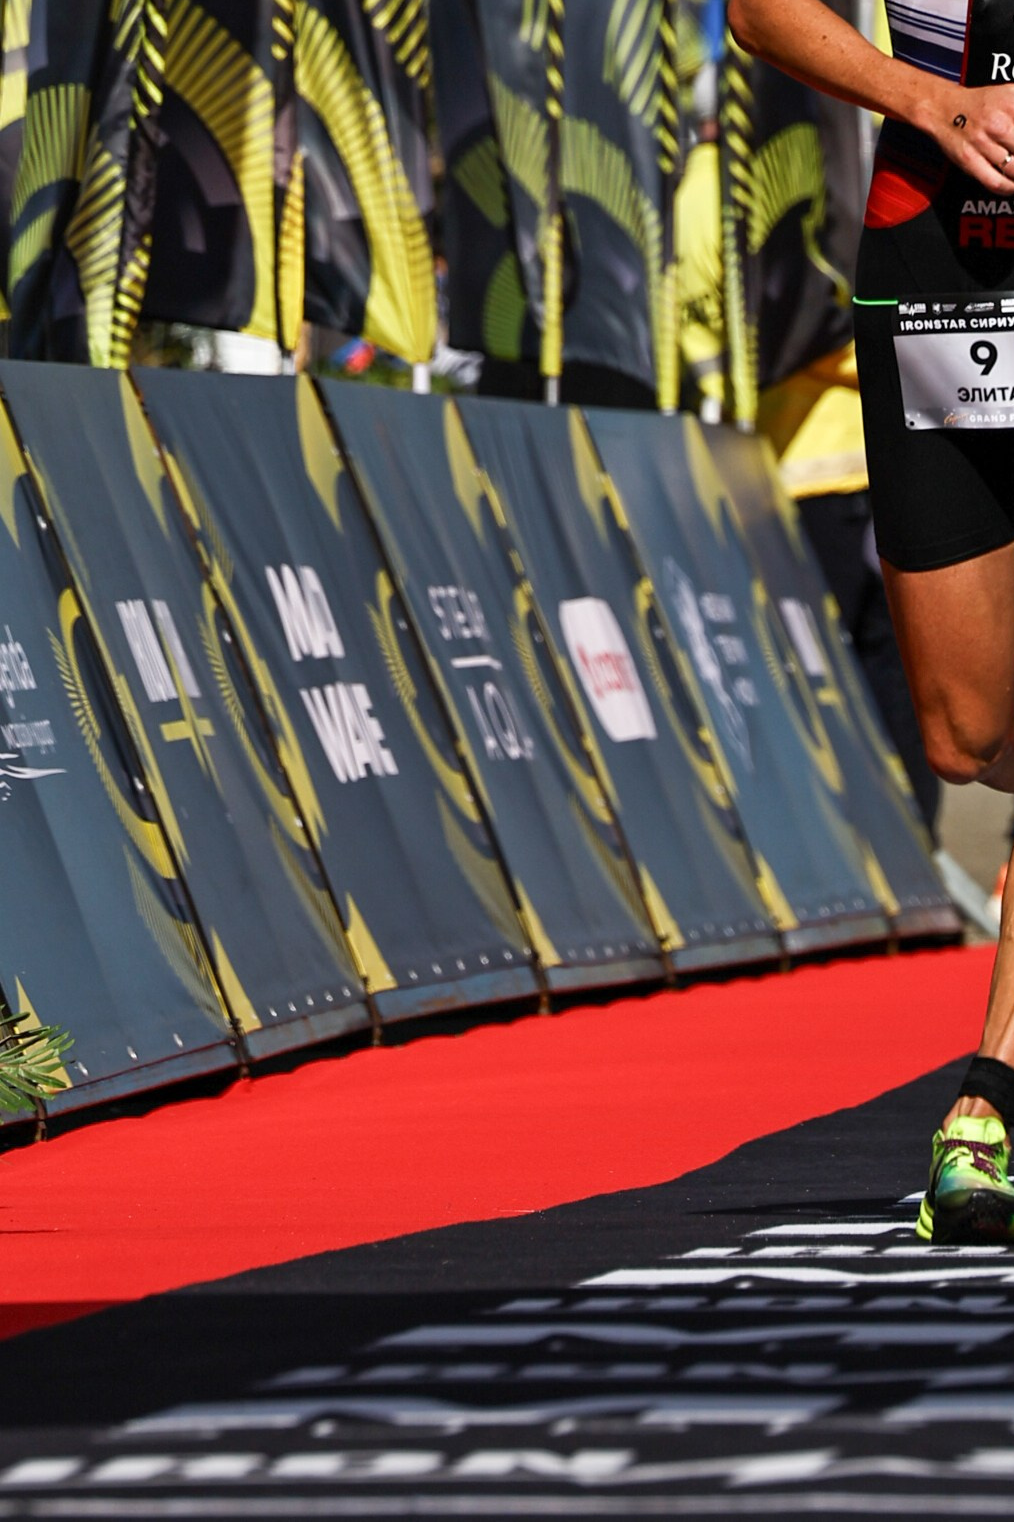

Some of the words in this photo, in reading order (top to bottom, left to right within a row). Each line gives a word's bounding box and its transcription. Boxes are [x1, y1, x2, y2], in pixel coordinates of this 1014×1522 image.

[900, 318, 967, 331] IRONSTAR
[969, 339, 998, 376] 9
[969, 413, 1006, 425] GRAND
